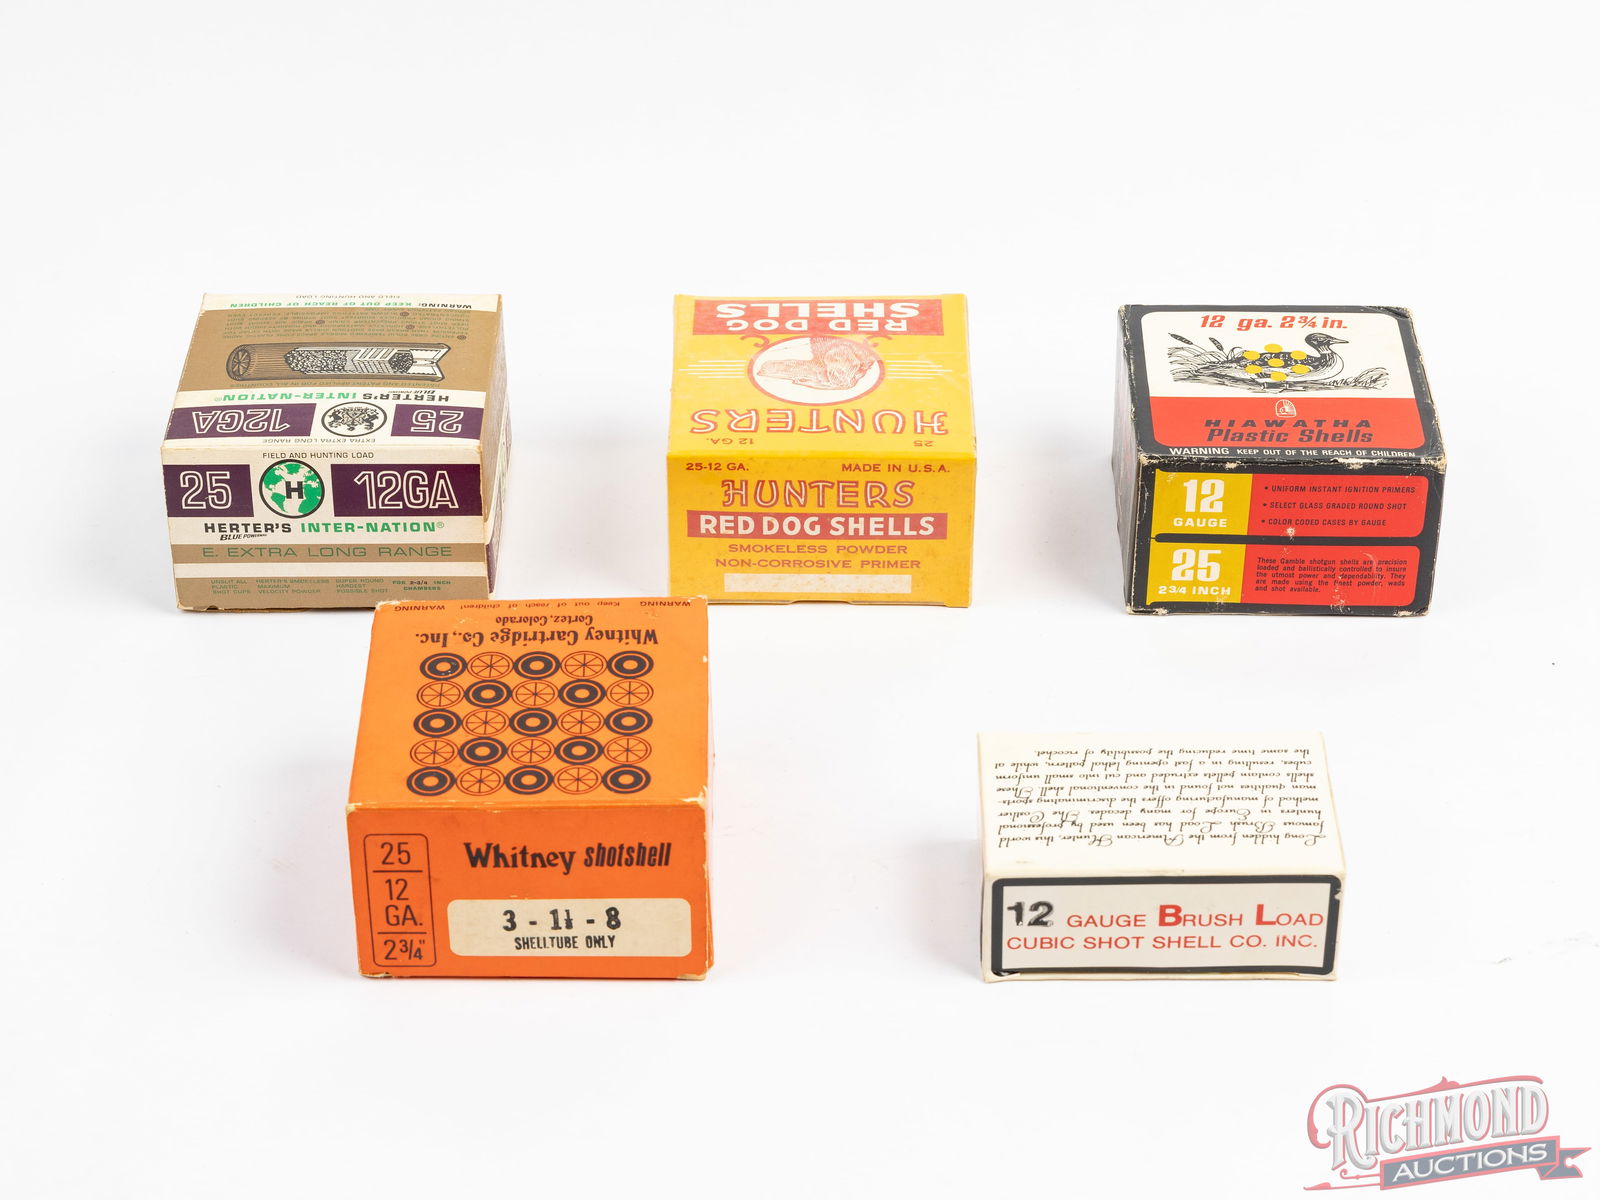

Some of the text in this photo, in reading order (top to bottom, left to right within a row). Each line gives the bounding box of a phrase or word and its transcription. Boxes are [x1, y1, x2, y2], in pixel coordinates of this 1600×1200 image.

[714, 300, 922, 318] SHELLS
[726, 319, 908, 332] RED DOG
[1201, 315, 1225, 328] 12
[1237, 318, 1272, 331] ga.
[1322, 317, 1348, 329] in.
[363, 393, 450, 402] HERTER'S
[192, 408, 290, 434] 12GA
[410, 409, 464, 434] 25
[690, 408, 948, 436] HUNTERS
[1204, 419, 1371, 428] HIAWATHA
[1206, 428, 1374, 443] Plastic Shells
[911, 440, 934, 448] 25
[262, 452, 287, 460] FIELD
[287, 452, 307, 460] AND
[1355, 448, 1367, 456] OF
[686, 462, 749, 472] 25-12 GA.
[841, 463, 950, 473] MADE IN U.S.A.
[180, 471, 232, 509] 25
[286, 480, 304, 499] H
[353, 470, 459, 509] 12GA
[721, 479, 916, 508] HUNTERS
[1183, 479, 1224, 513] 12
[1272, 485, 1306, 493] UNIFORM
[1345, 486, 1378, 494] IGNITION
[1382, 486, 1415, 494] PRIMERS
[1269, 501, 1296, 510] SELECT
[1299, 502, 1323, 510] GLASS
[1326, 502, 1356, 510] GRADED
[204, 523, 291, 533] HERTER'S
[699, 514, 934, 536] RED DOG SHELLS
[1173, 518, 1226, 527] GAUGE
[1268, 518, 1292, 526] COLOR
[1295, 518, 1319, 526] CODED
[202, 546, 453, 557] E. EXTRA LONG RANGE
[728, 544, 908, 554] SMOKELESS POWDER
[715, 559, 921, 569] NON-CORROSIVE PRIMER
[1171, 549, 1222, 583] 25
[1192, 587, 1230, 595] INCH
[393, 604, 445, 612] WARNING
[496, 615, 593, 626] Cortez, Colorado
[416, 633, 448, 648] Inc.
[490, 628, 578, 646] Cartridge
[585, 626, 658, 645] Whitney
[998, 833, 1031, 848] world
[1117, 834, 1184, 846] American
[1188, 832, 1205, 845] the
[1209, 832, 1238, 846] from
[1242, 832, 1280, 845] hidden
[1284, 832, 1326, 846] Long
[380, 842, 411, 865] 25
[464, 842, 672, 875] Whitney shotshell
[385, 878, 409, 901] 12
[384, 904, 423, 926] GA.
[503, 910, 517, 932] 3
[605, 906, 621, 930] 8
[1007, 901, 1053, 926] 12
[1067, 914, 1146, 928] GAUGE
[585, 935, 615, 948] ONLY
[1007, 934, 1317, 950] CUBIC SHOT SHELL CO. INC.
